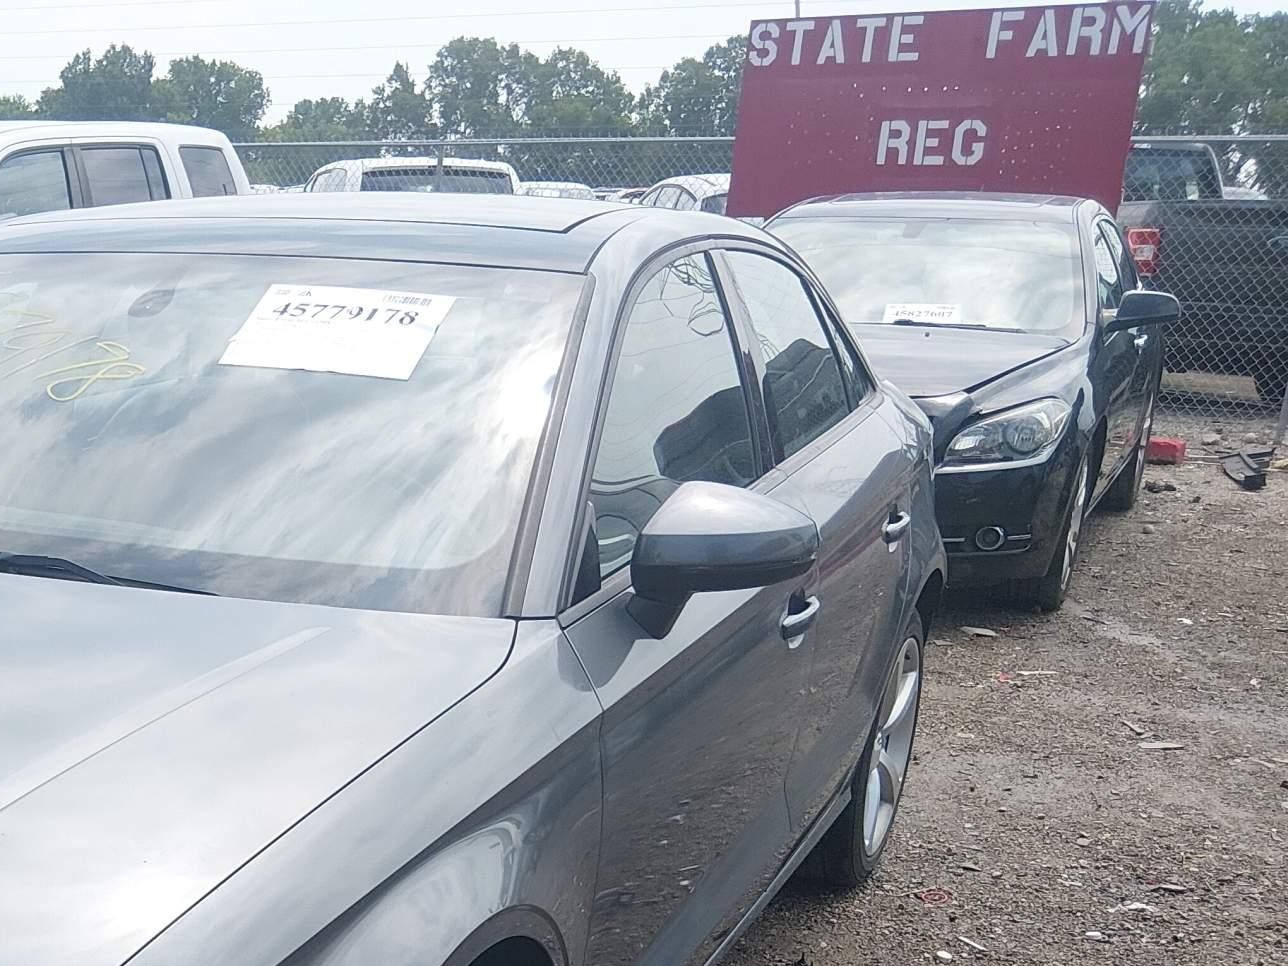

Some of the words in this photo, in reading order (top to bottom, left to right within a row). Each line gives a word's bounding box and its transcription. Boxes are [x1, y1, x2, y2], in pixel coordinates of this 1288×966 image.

[749, 15, 925, 67] STATE
[985, 3, 1152, 59] FARM
[876, 119, 988, 166] REG
[272, 301, 420, 326] 45779178
